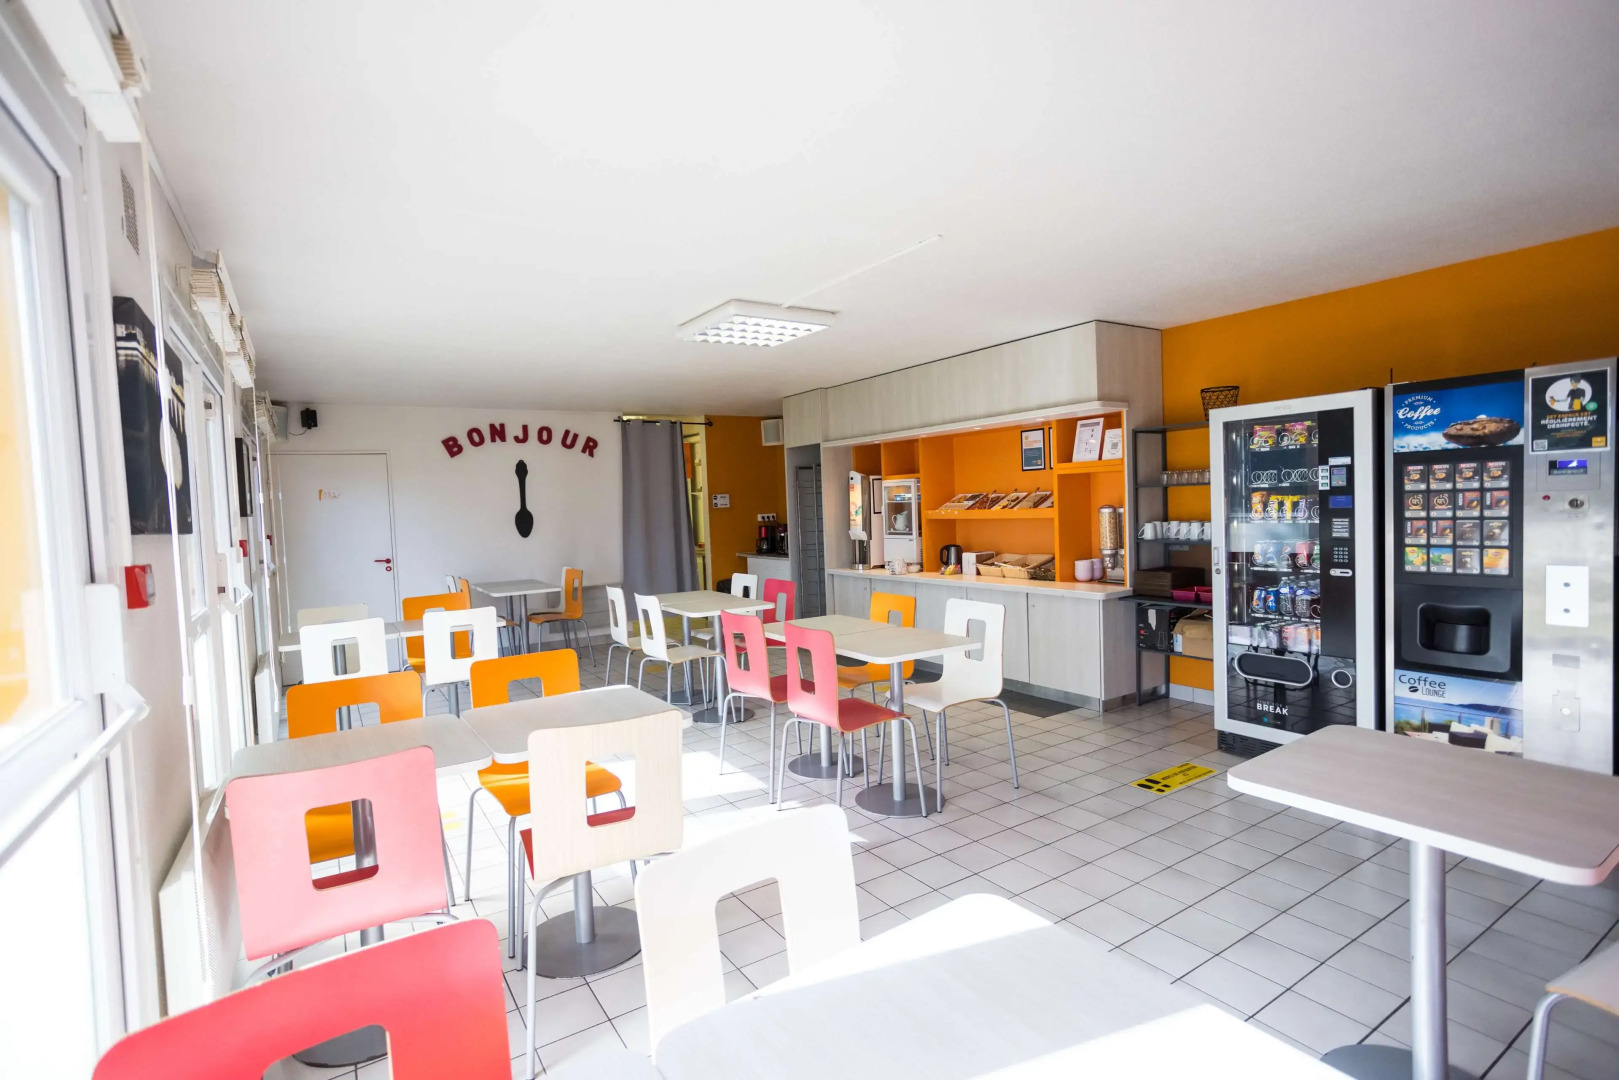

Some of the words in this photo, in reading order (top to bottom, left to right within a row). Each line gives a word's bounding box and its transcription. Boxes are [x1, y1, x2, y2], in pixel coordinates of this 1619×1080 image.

[1404, 395, 1434, 405] PREMIUM
[1396, 405, 1441, 420] Coffee
[1404, 420, 1435, 431] PRODUCTS
[441, 423, 599, 458] BONJOUR
[1398, 674, 1446, 690] Coffee
[1421, 686, 1446, 698] LOUNGE
[1256, 702, 1289, 716] BREAK
